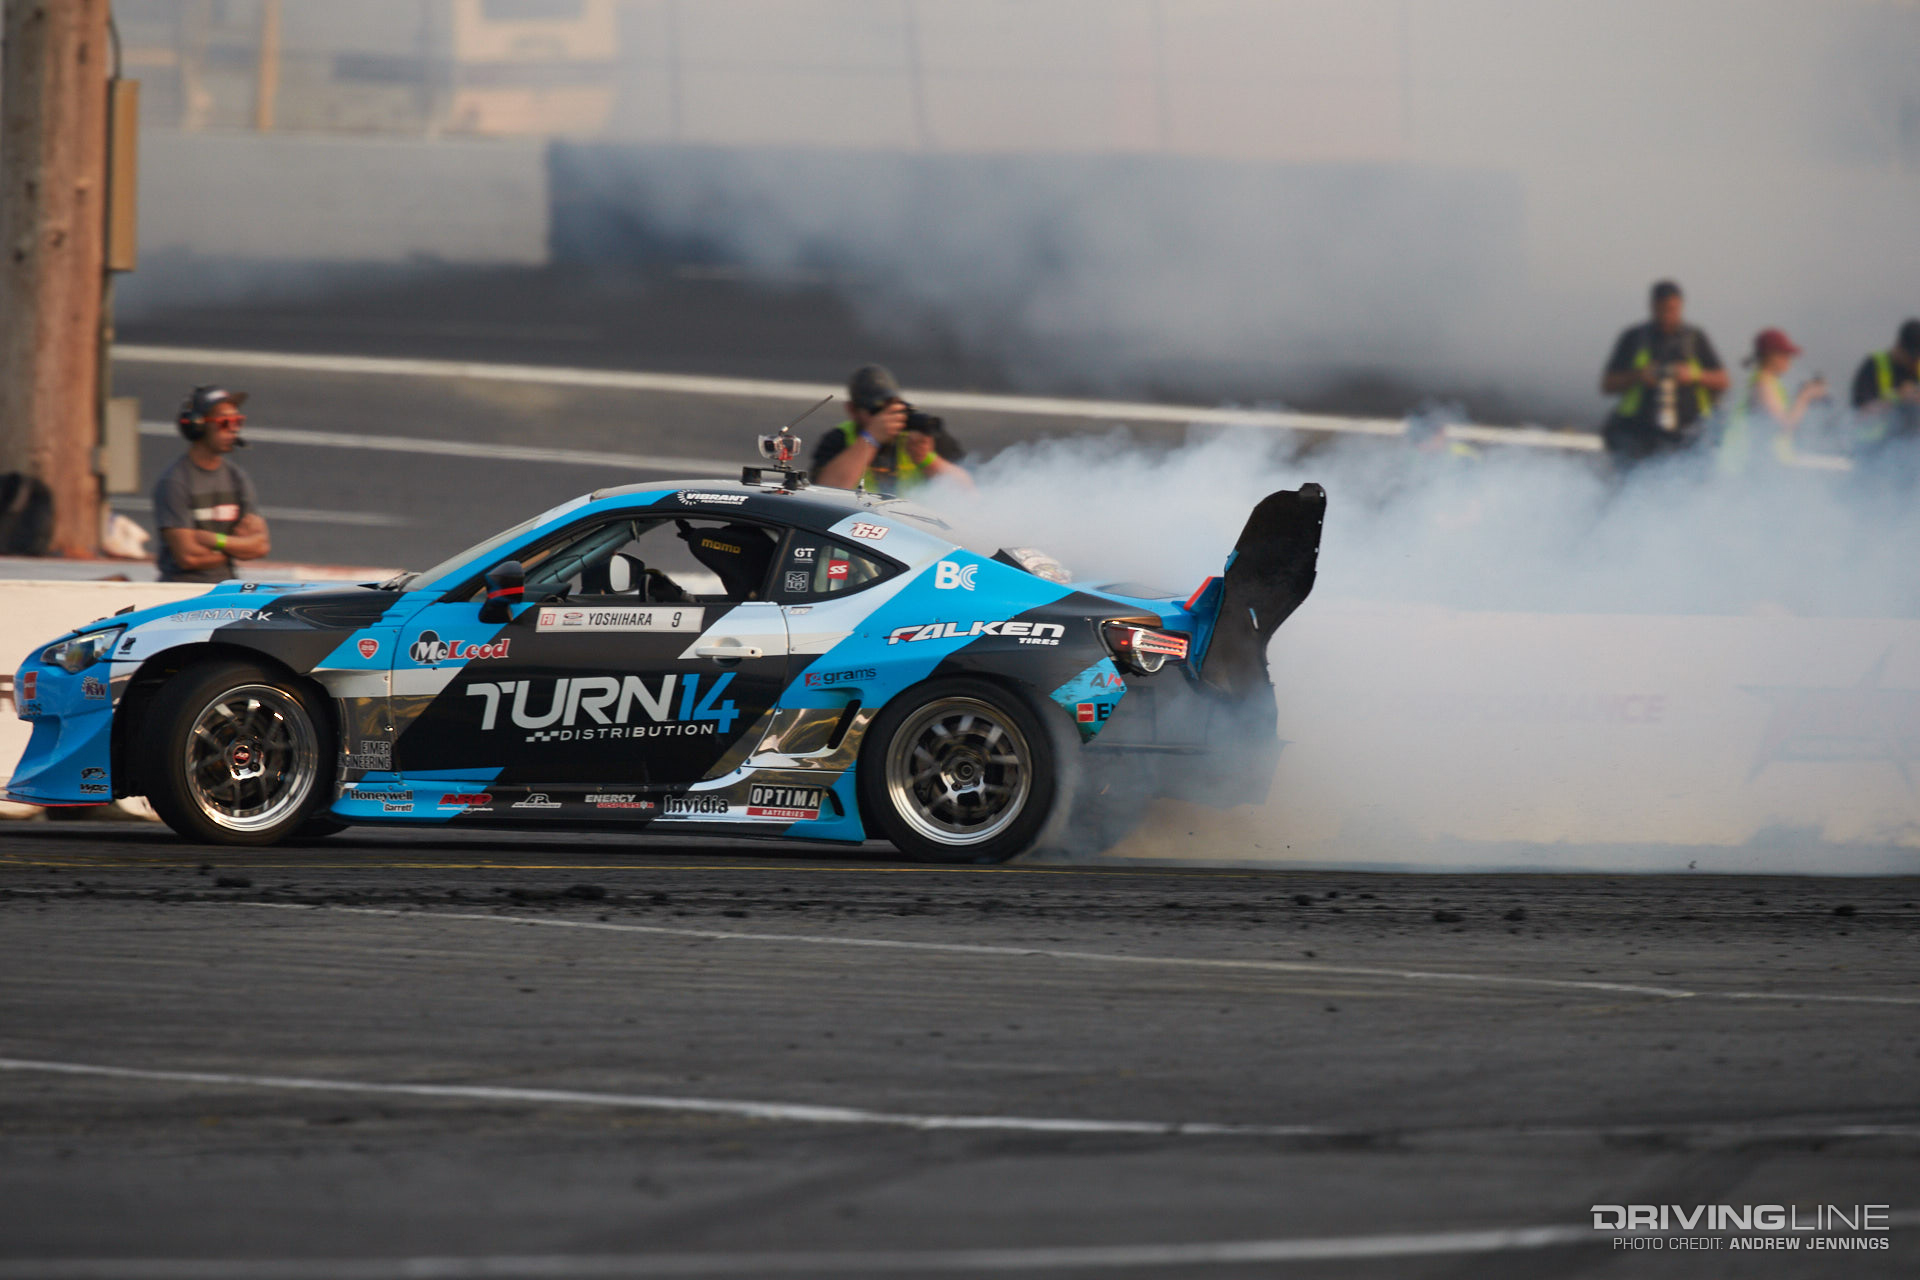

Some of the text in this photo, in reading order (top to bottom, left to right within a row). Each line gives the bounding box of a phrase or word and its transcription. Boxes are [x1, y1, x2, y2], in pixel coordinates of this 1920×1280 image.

[686, 493, 749, 502] VIBRANT
[794, 547, 815, 558] GT
[588, 612, 652, 626] YOSHIHARA
[671, 611, 682, 628] 9
[883, 620, 1066, 645] FALKEN
[1018, 637, 1059, 646] TIRES
[415, 638, 511, 661] McLeod
[823, 668, 877, 684] grams
[560, 724, 714, 741] DISTRIBUTION
[350, 790, 413, 803] Honeywell
[438, 793, 492, 805] ARP
[584, 794, 636, 803] ENERGY
[751, 788, 819, 807] OPTIMA
[383, 803, 414, 813] Garrett
[664, 794, 729, 814] Invidia
[761, 809, 805, 817] BATTERIES
